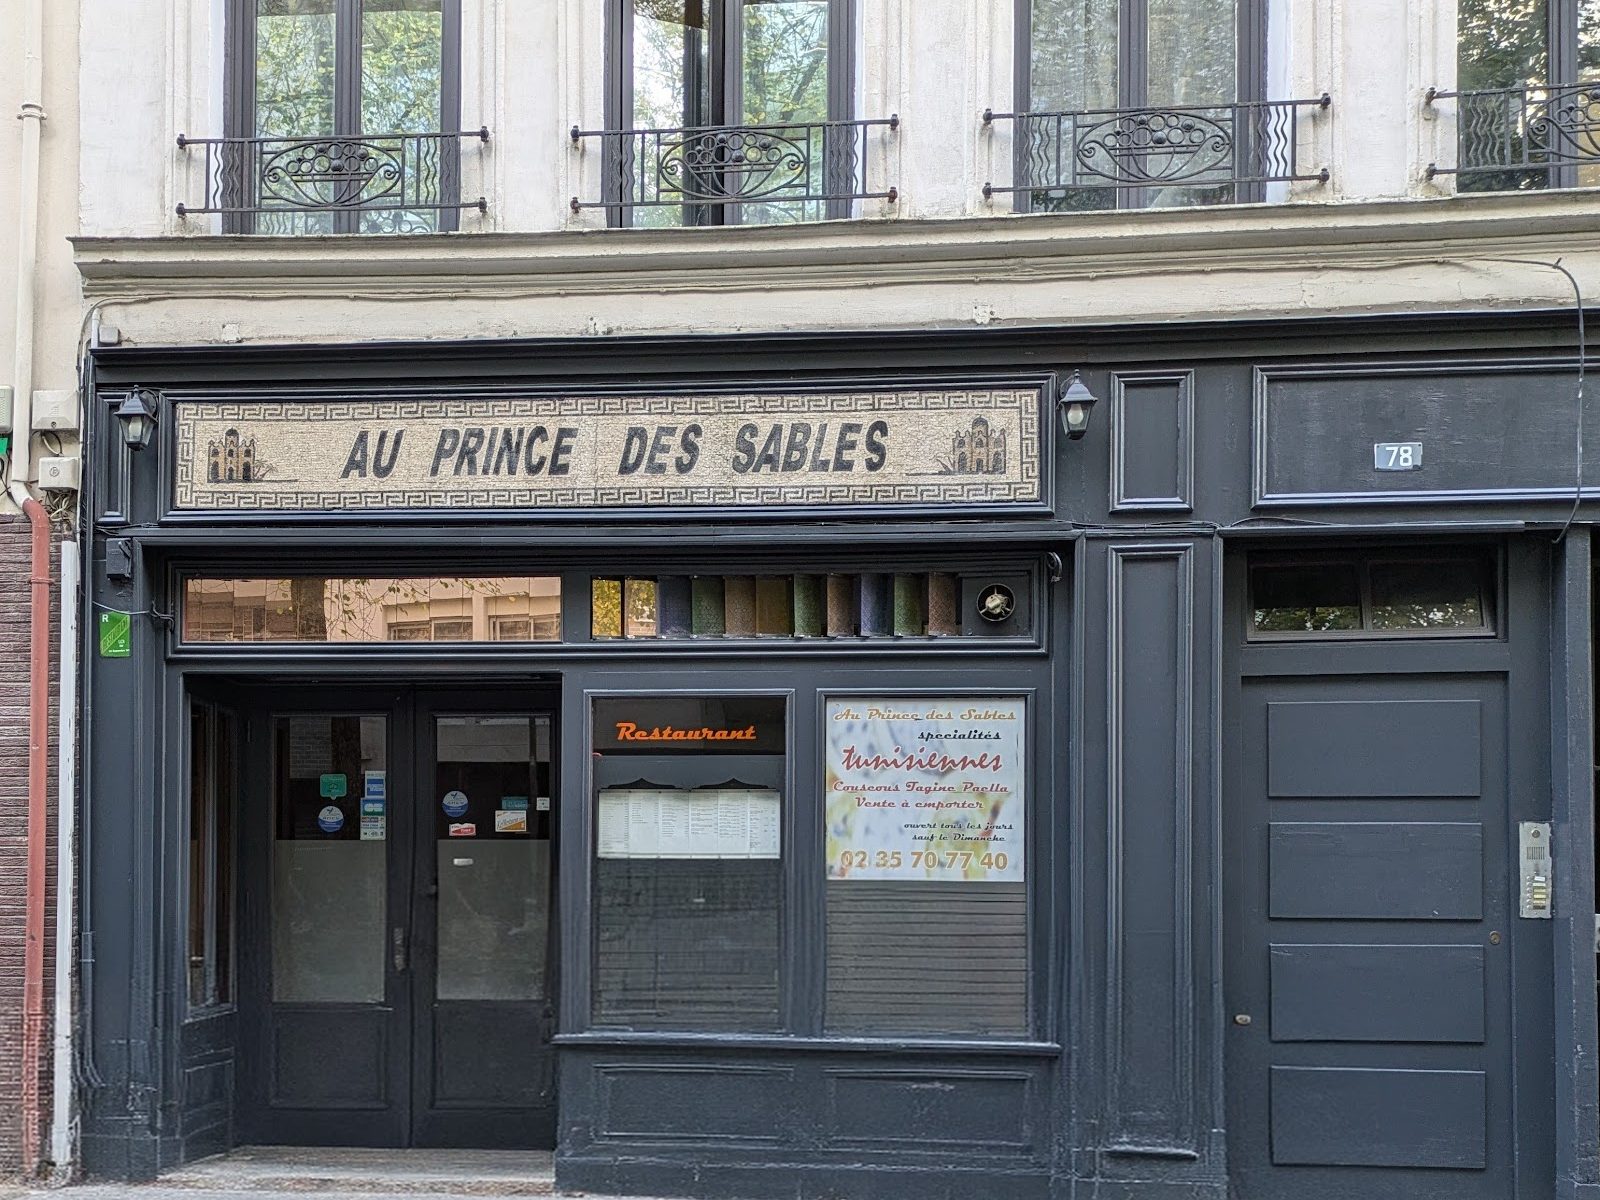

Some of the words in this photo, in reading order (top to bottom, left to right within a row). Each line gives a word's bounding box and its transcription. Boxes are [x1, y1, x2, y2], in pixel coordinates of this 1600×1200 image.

[340, 429, 405, 479] AU
[430, 425, 579, 478] PRINCE
[618, 423, 702, 475] DES
[732, 420, 888, 473] SABLES
[1385, 446, 1413, 467] 78
[834, 708, 861, 721] Au
[867, 707, 920, 721] Prince
[925, 708, 954, 720] des
[960, 708, 1017, 721] Sables
[616, 722, 757, 741] Restaurant
[842, 745, 1003, 772] tunisiennes
[833, 781, 901, 793] Couscous
[905, 781, 956, 795] Tagine
[962, 781, 1009, 793] Paella
[855, 797, 897, 809] Vente
[901, 799, 911, 808] à
[915, 800, 985, 811] emporter
[903, 822, 937, 830] ouvert
[966, 822, 981, 830] les
[984, 821, 1014, 831] jours
[912, 834, 936, 842] sauf
[938, 833, 949, 842] le
[952, 833, 1007, 843] Dimanche
[840, 851, 868, 868] 02
[875, 851, 902, 868] 35
[911, 852, 938, 869] 70
[945, 853, 973, 870] 77
[980, 853, 1008, 871] 40
